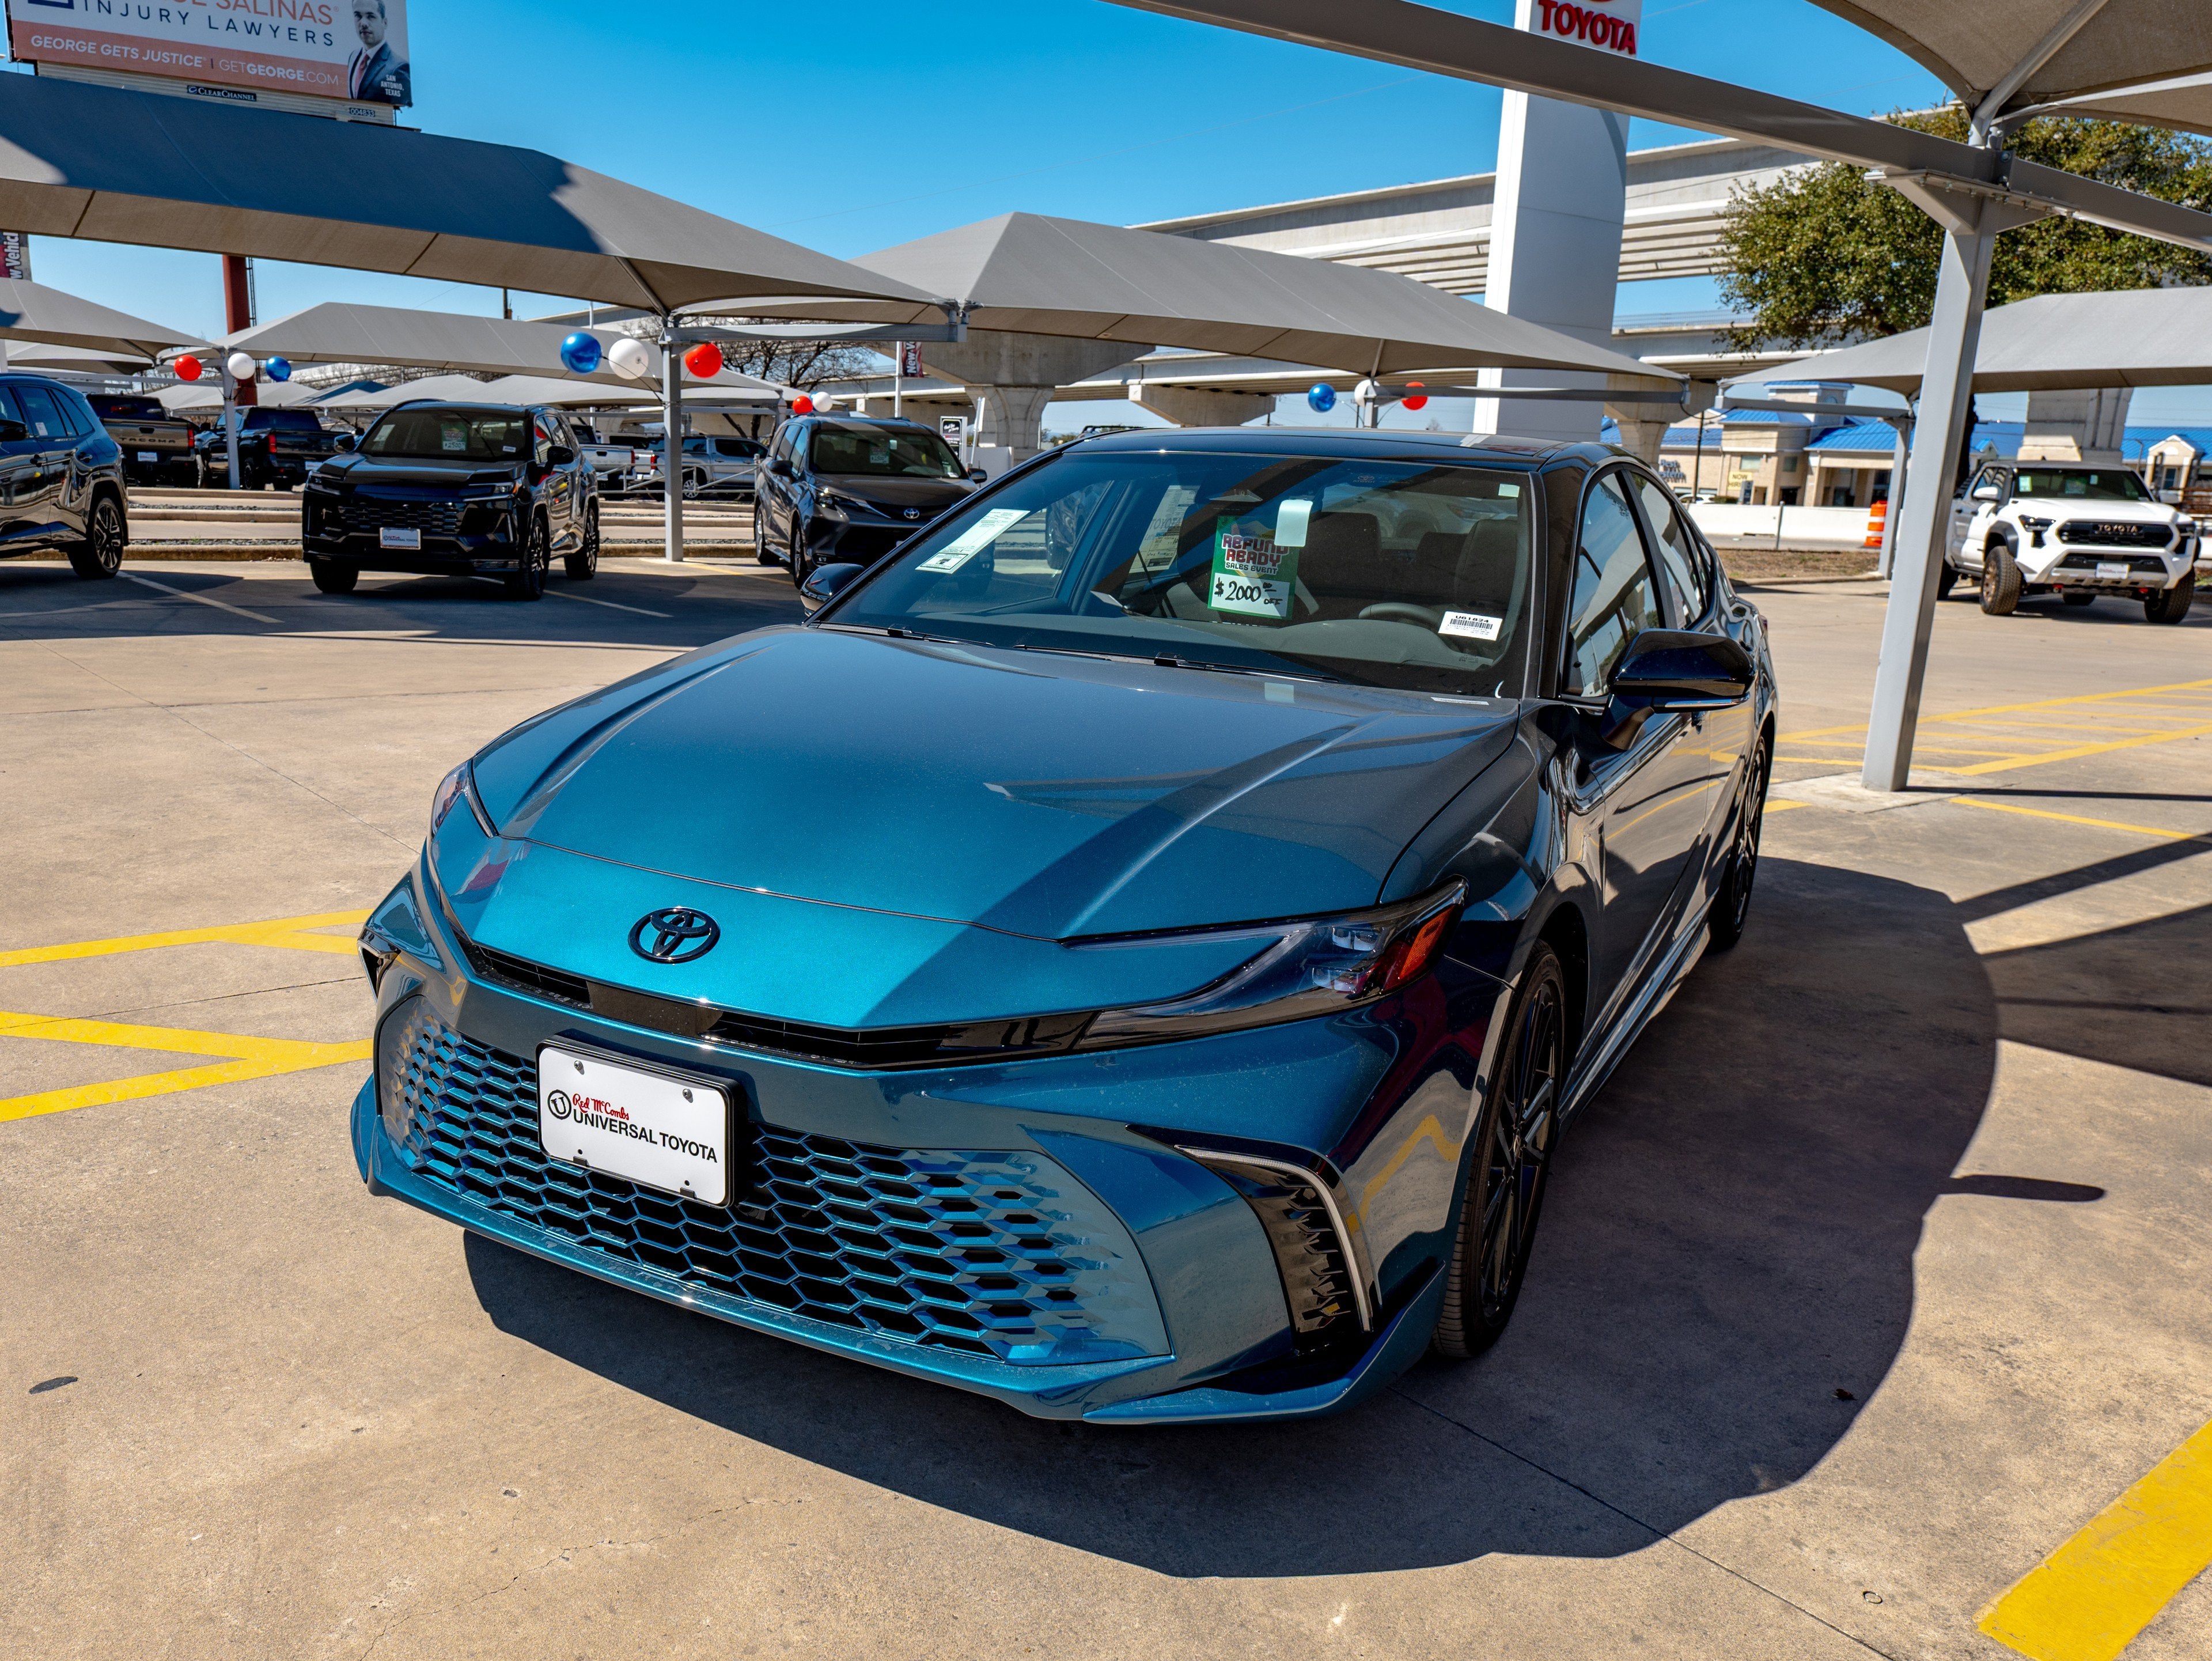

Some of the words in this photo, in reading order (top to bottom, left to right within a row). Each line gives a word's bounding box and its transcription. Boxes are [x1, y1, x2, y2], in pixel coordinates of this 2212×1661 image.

[85, 0, 189, 25] INJURY
[208, 15, 333, 46] LAWYERS
[1539, 0, 1636, 55] TOYOTA
[31, 35, 97, 54] GEORGE
[100, 44, 139, 59] GETS
[142, 50, 202, 67] JUSTICE
[219, 59, 339, 85] GETGEORGE.COM
[381, 81, 404, 91] ANTONIO,
[385, 89, 401, 97] TEXAS
[350, 108, 375, 117] 004833
[3, 232, 21, 267] Vehicl
[907, 351, 917, 373] New
[1658, 470, 1684, 478] estern
[2098, 524, 2138, 532] TOYOTA
[1223, 534, 1289, 554] REFUND
[1226, 548, 1281, 567] READY
[1226, 562, 1249, 570] SALES
[1251, 565, 1278, 574] EVENT
[1263, 597, 1283, 606] OFF
[573, 1094, 590, 1114] Red
[590, 1098, 630, 1121] McCombs
[573, 1108, 658, 1145] UNIVERSAL
[659, 1132, 718, 1163] TOYOTA
